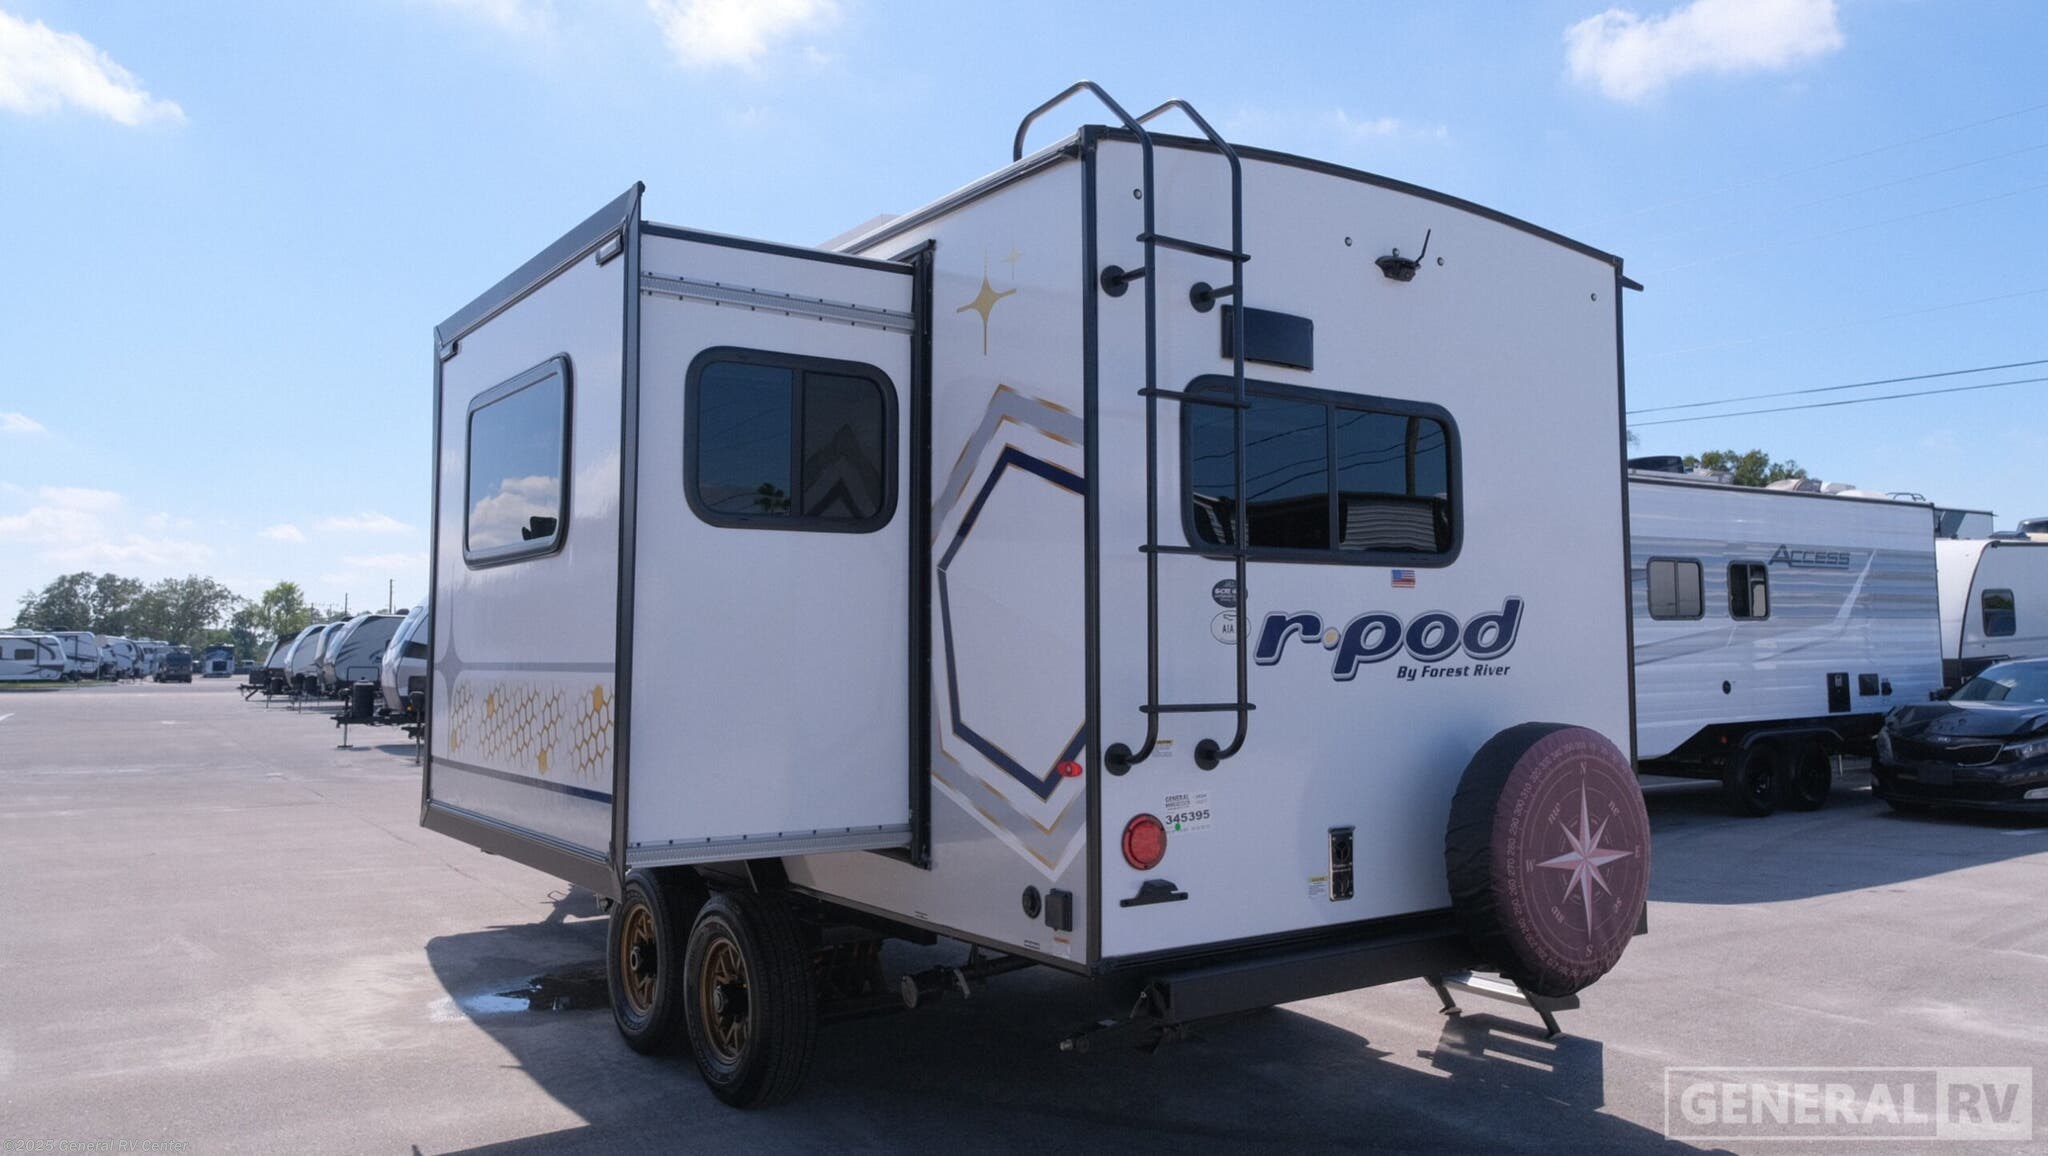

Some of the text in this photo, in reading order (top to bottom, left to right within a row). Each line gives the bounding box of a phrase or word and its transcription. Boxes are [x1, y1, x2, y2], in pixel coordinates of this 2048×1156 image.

[1397, 664, 1511, 682] By Forest River
[1165, 809, 1211, 825] 345395
[1585, 944, 1593, 958] S
